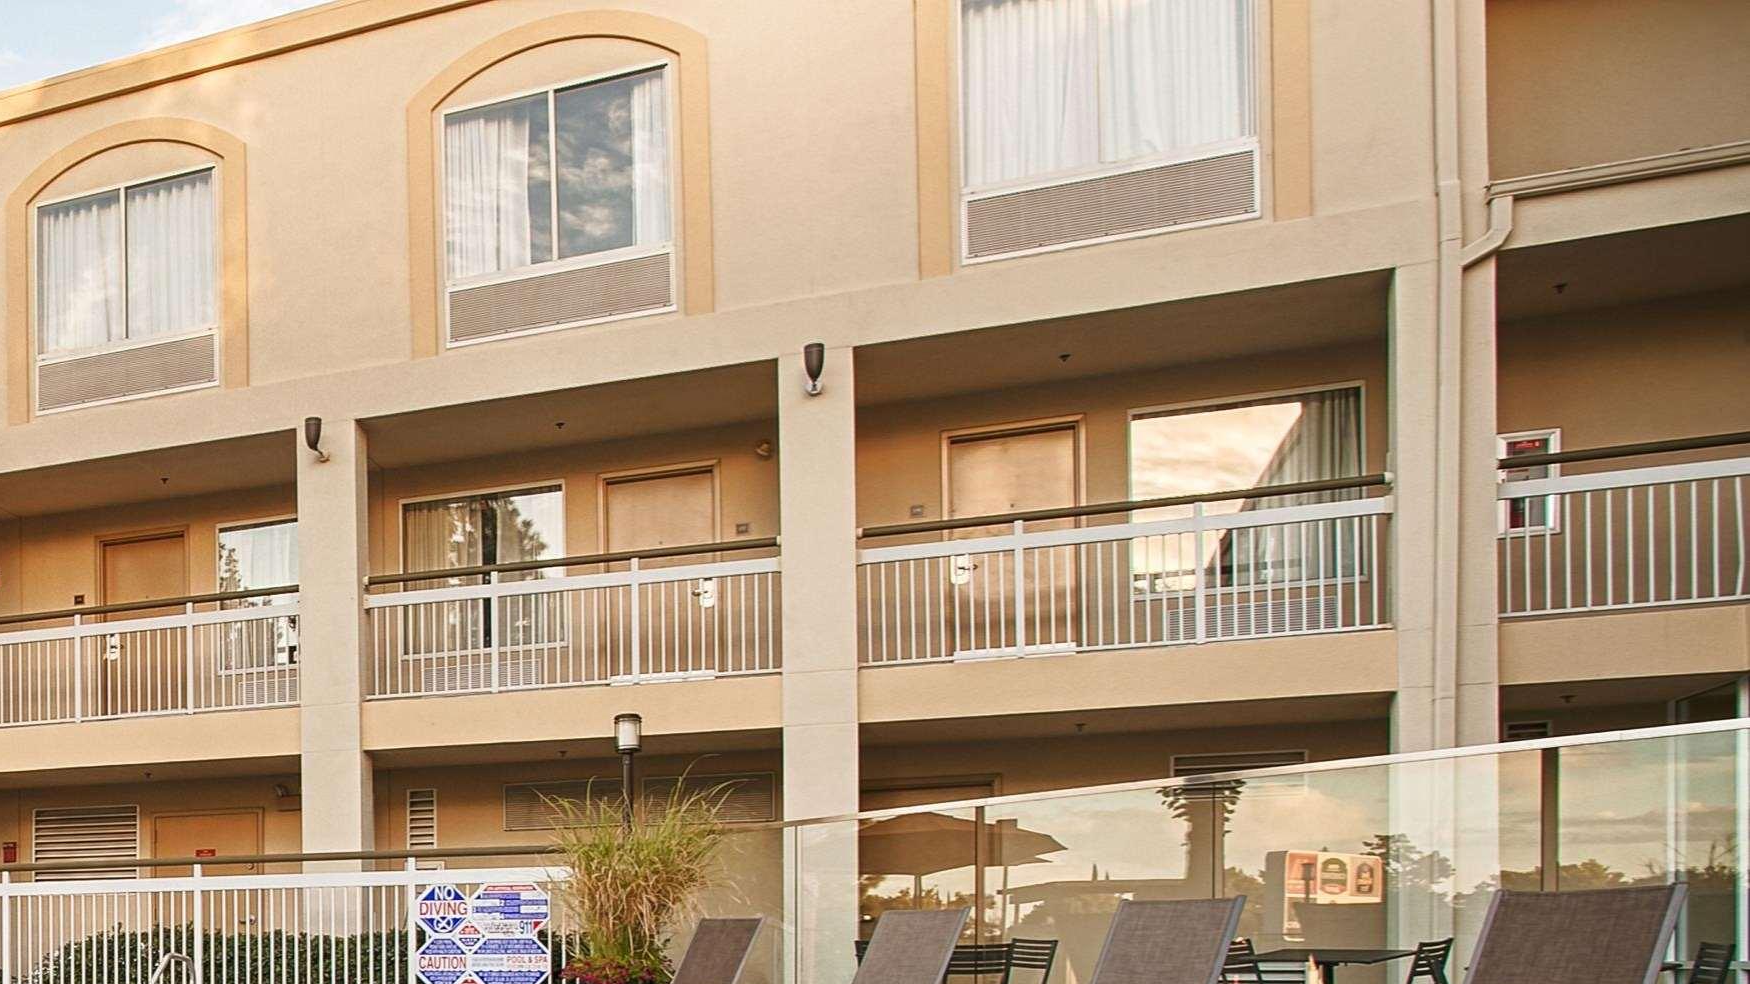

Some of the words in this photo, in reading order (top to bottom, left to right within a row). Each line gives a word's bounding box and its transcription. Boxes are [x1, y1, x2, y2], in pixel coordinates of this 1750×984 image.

[434, 885, 454, 900] NO
[419, 901, 468, 916] DIVING
[519, 920, 533, 935] 911
[419, 956, 467, 969] CAUTION
[506, 955, 525, 964] POOL
[534, 955, 548, 964] SPA
